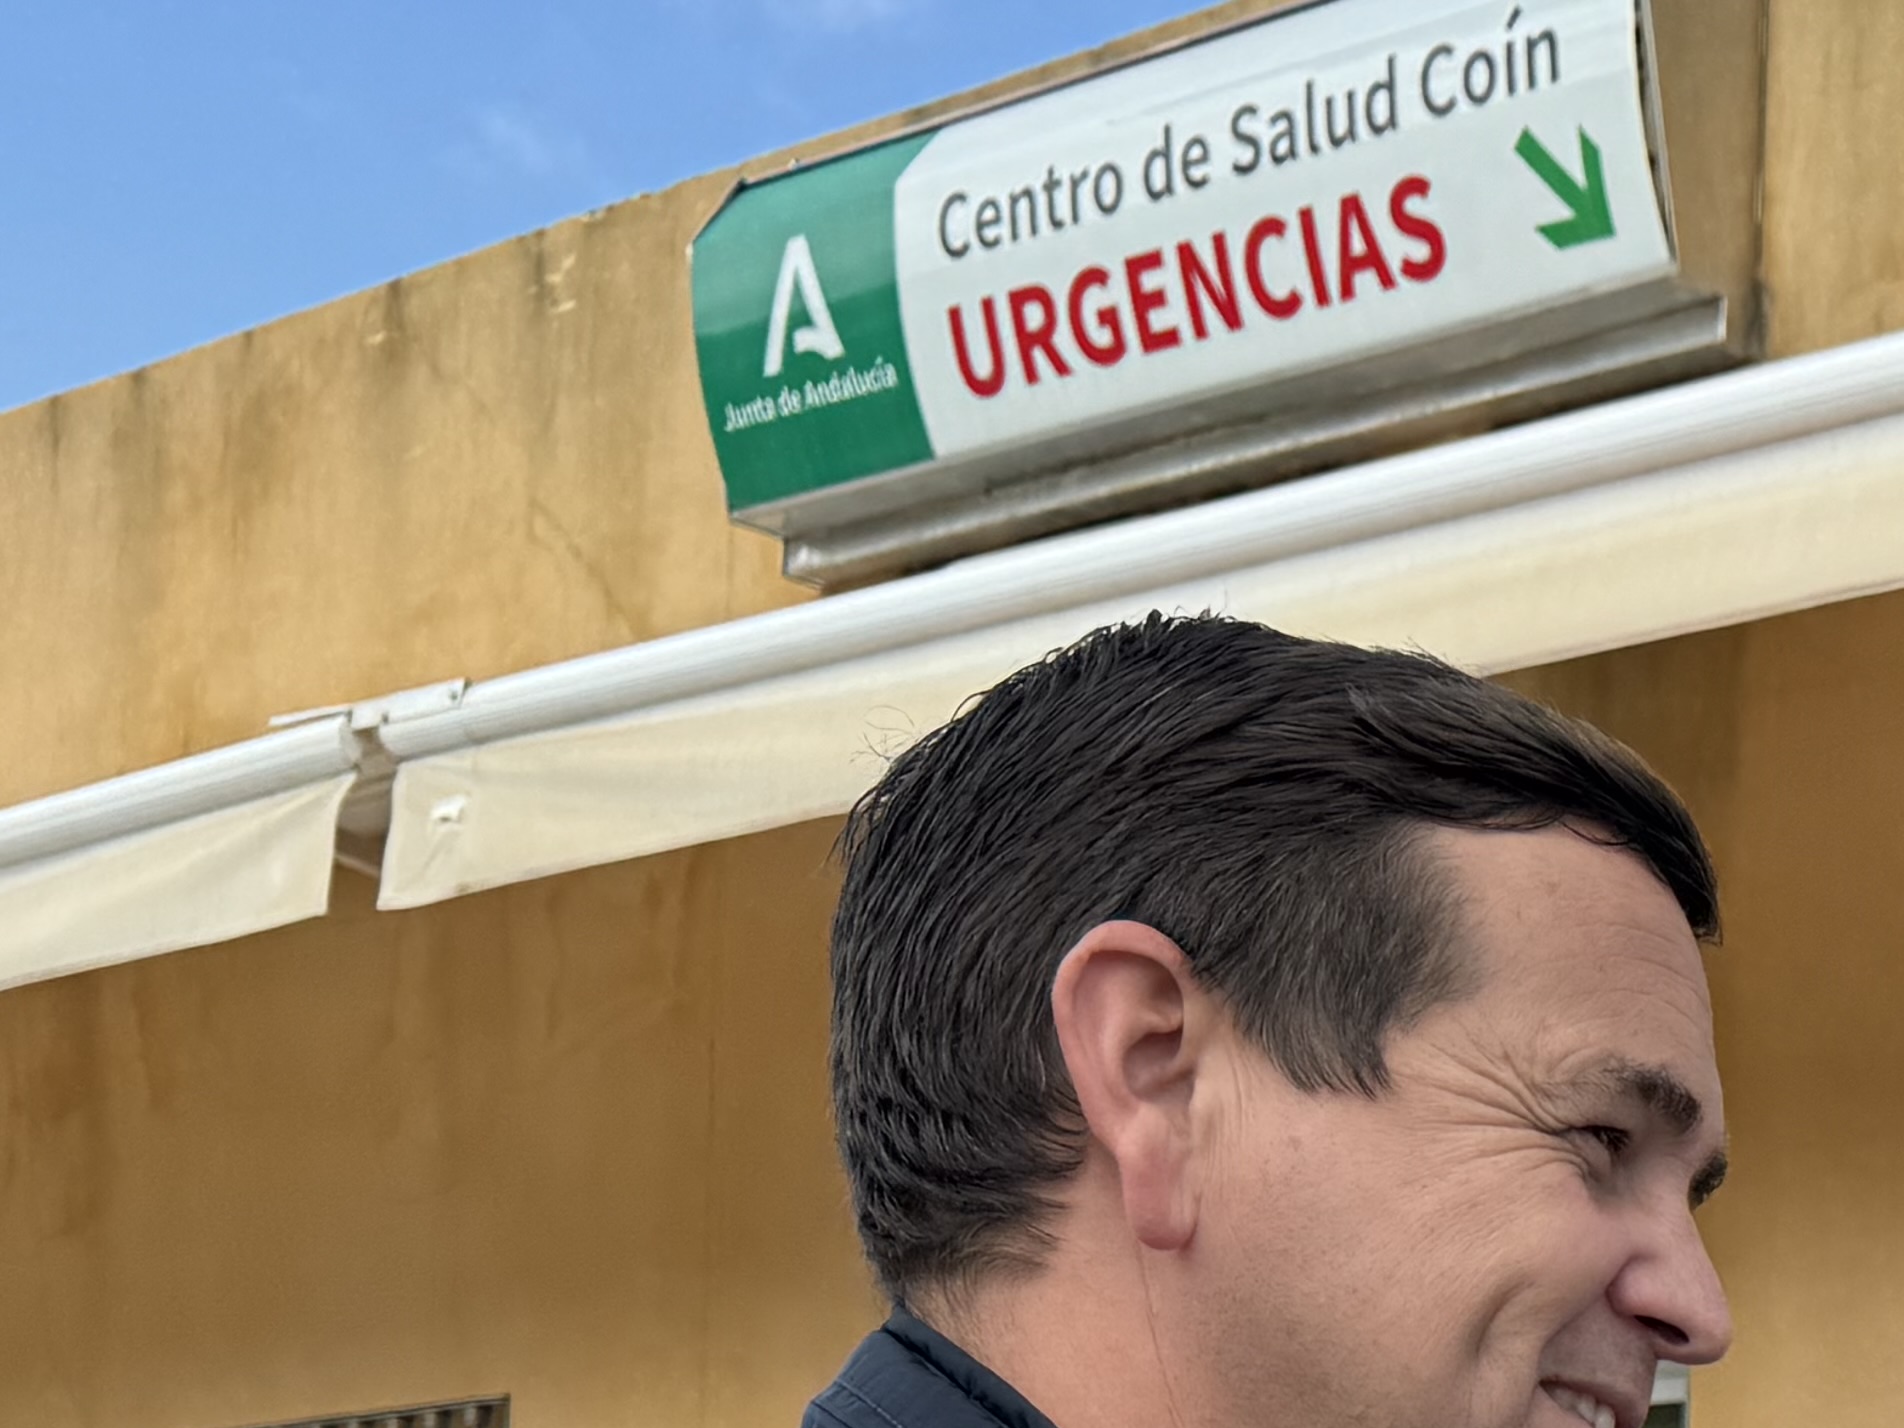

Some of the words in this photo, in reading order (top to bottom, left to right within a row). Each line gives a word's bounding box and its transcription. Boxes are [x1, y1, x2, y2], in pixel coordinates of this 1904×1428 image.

[938, 162, 1124, 261] Centro
[1142, 123, 1211, 204] de
[1230, 54, 1399, 178] Salud
[1419, 6, 1560, 118] Coín
[724, 395, 777, 432] Junta
[778, 385, 801, 417] de
[802, 354, 899, 410] Andalucía
[947, 175, 1446, 398] URGENCIAS
